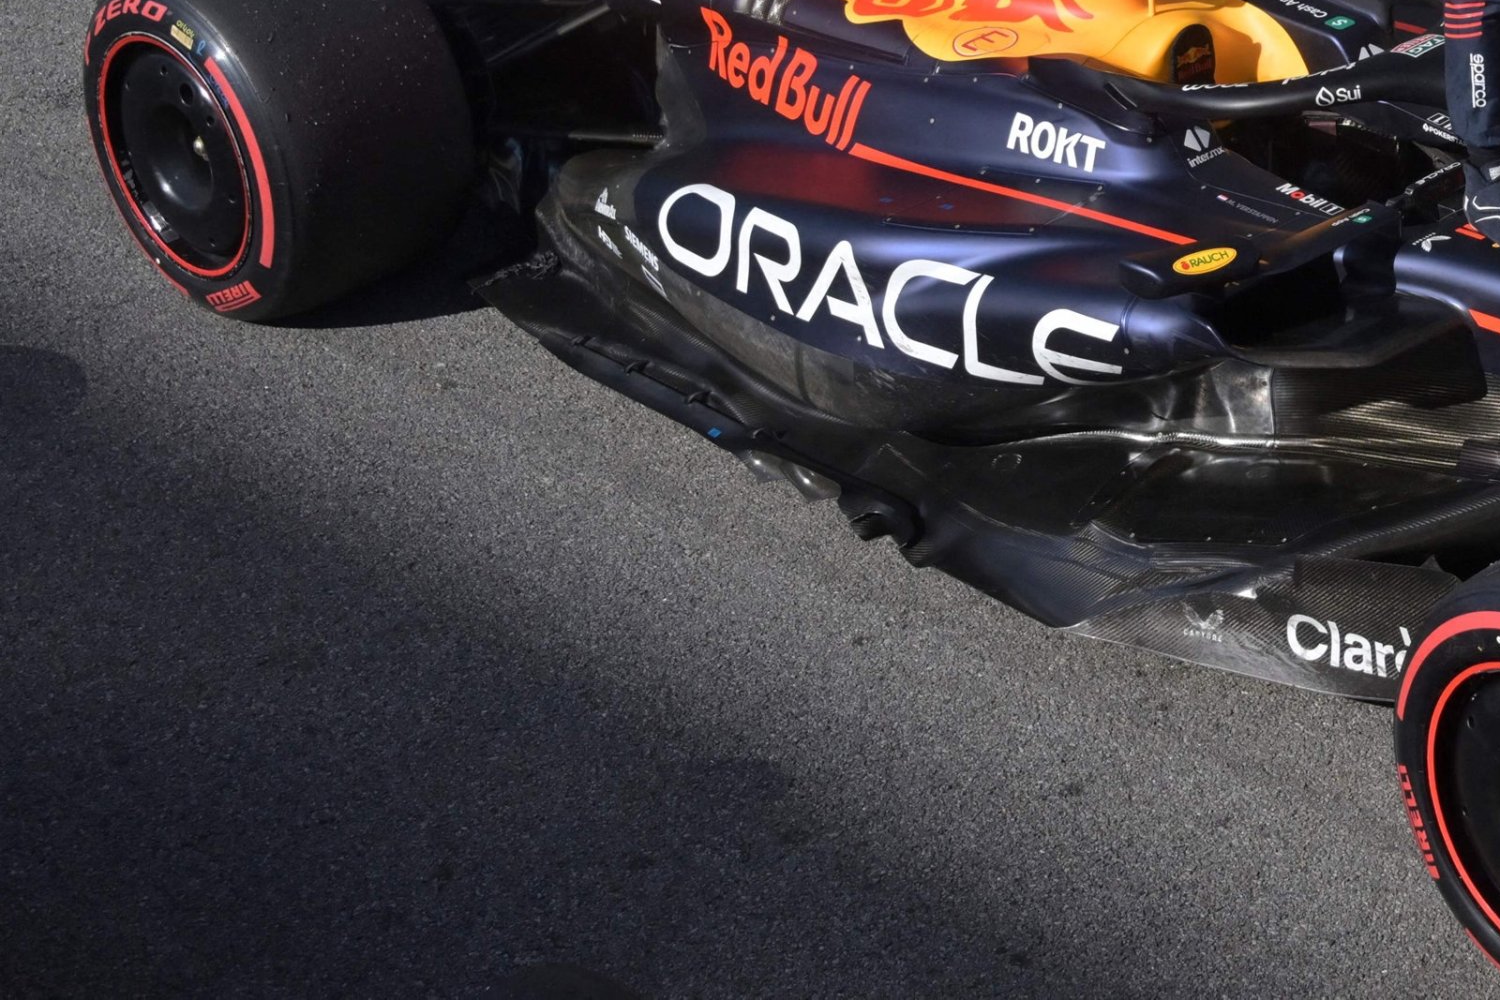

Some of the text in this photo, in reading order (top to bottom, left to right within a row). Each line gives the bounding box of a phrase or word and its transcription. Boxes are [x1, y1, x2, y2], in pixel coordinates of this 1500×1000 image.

[700, 6, 872, 150] Red Bull
[1335, 85, 1362, 102] Sui
[1472, 53, 1487, 108] sparco
[1006, 112, 1106, 173] ROKT
[1187, 145, 1227, 168] inter.mx
[1276, 182, 1327, 208] Mobil
[624, 225, 659, 271] SIEMENS
[1189, 250, 1230, 268] RAUCH
[658, 183, 1123, 386] ORACLE
